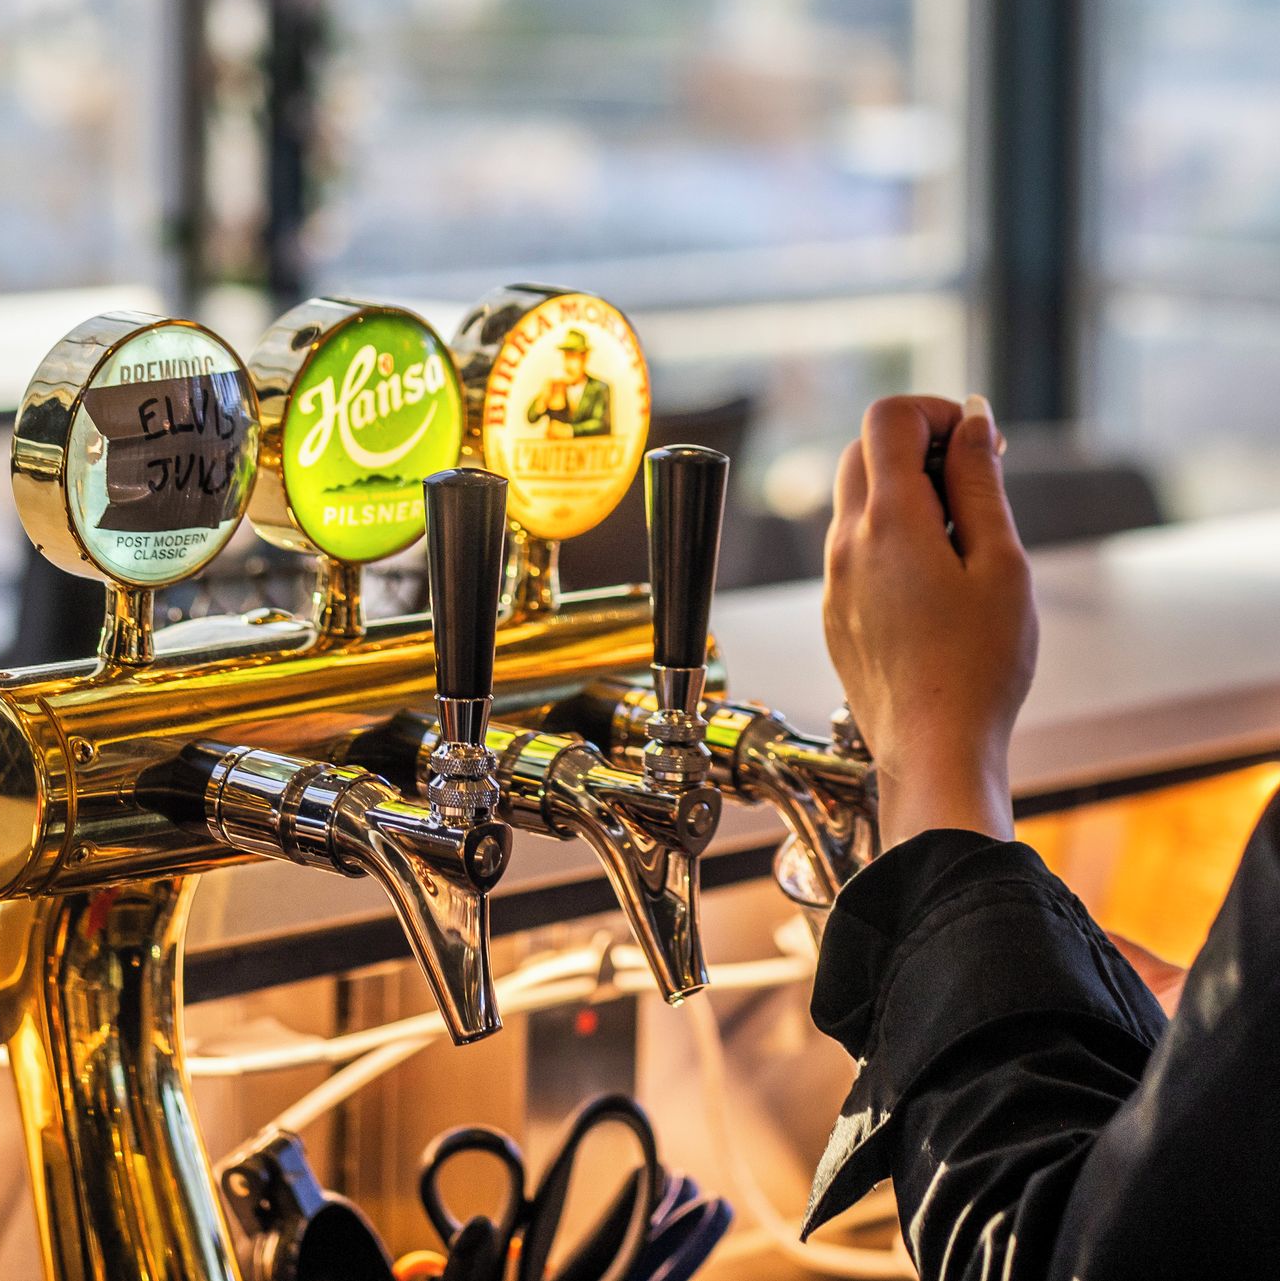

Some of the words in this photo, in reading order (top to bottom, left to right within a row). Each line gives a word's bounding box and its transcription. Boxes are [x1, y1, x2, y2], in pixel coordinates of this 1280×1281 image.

[487, 314, 552, 425] BIRRA
[298, 344, 447, 469] Hansa
[323, 499, 425, 527] PILSNER
[116, 536, 151, 549] POST
[153, 532, 209, 548] MODERN
[133, 547, 188, 561] CLASSIC
